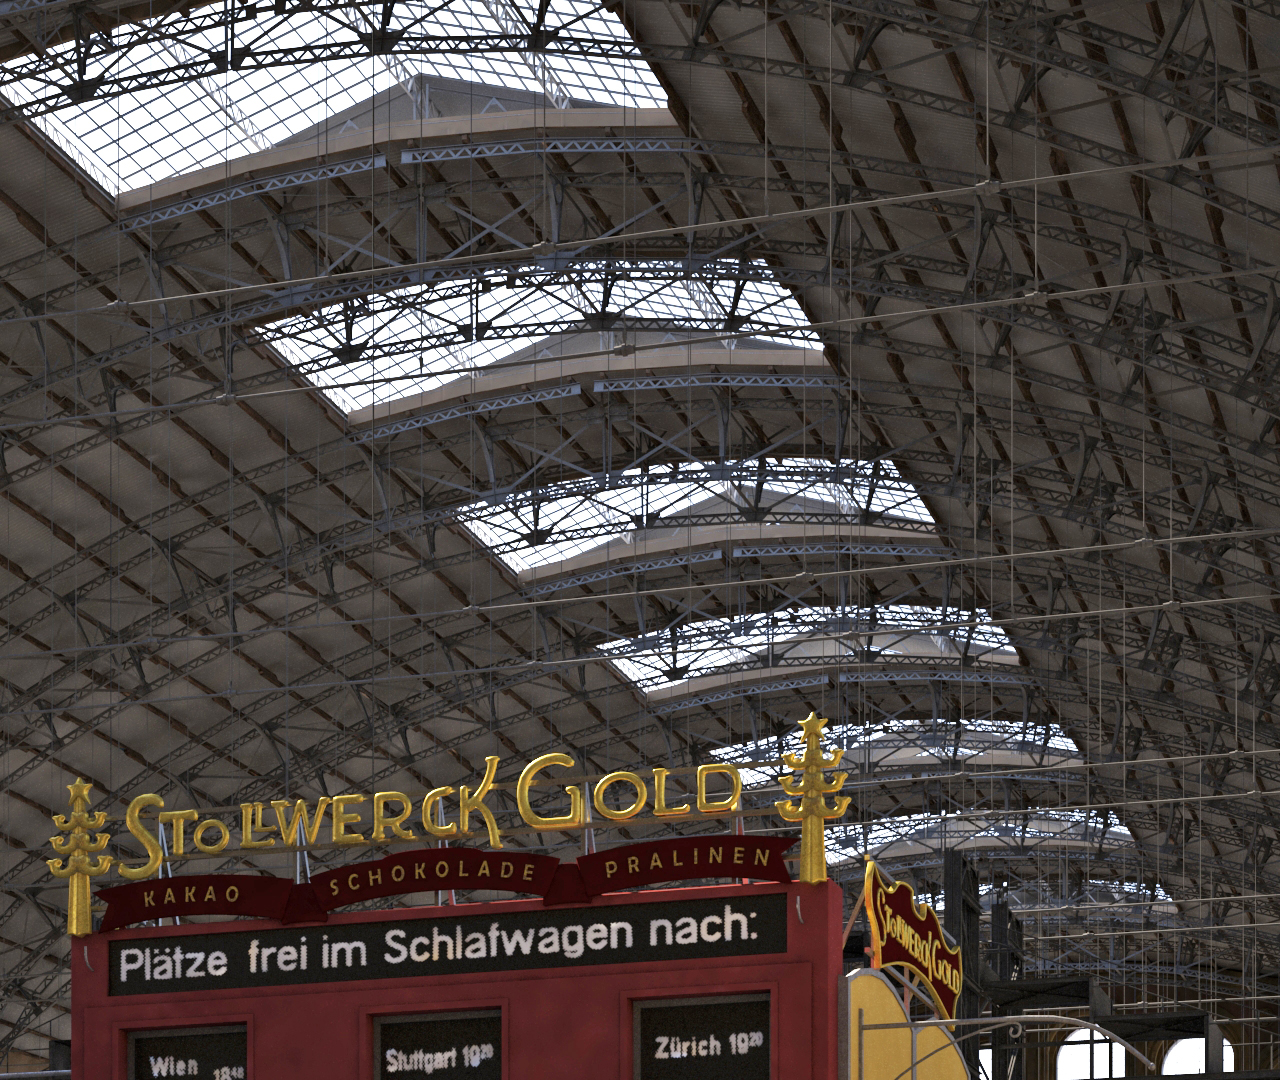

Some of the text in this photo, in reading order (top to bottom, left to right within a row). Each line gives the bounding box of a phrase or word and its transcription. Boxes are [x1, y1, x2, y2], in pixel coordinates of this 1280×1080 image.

[143, 846, 771, 908] KAKAO SCHOKOLADE PRALINEN
[120, 904, 758, 982] Plätze frei im Schlafwagen nach:
[385, 1046, 458, 1076] Stuttgart
[653, 1033, 722, 1059] Zürich
[149, 1055, 199, 1078] Wien
